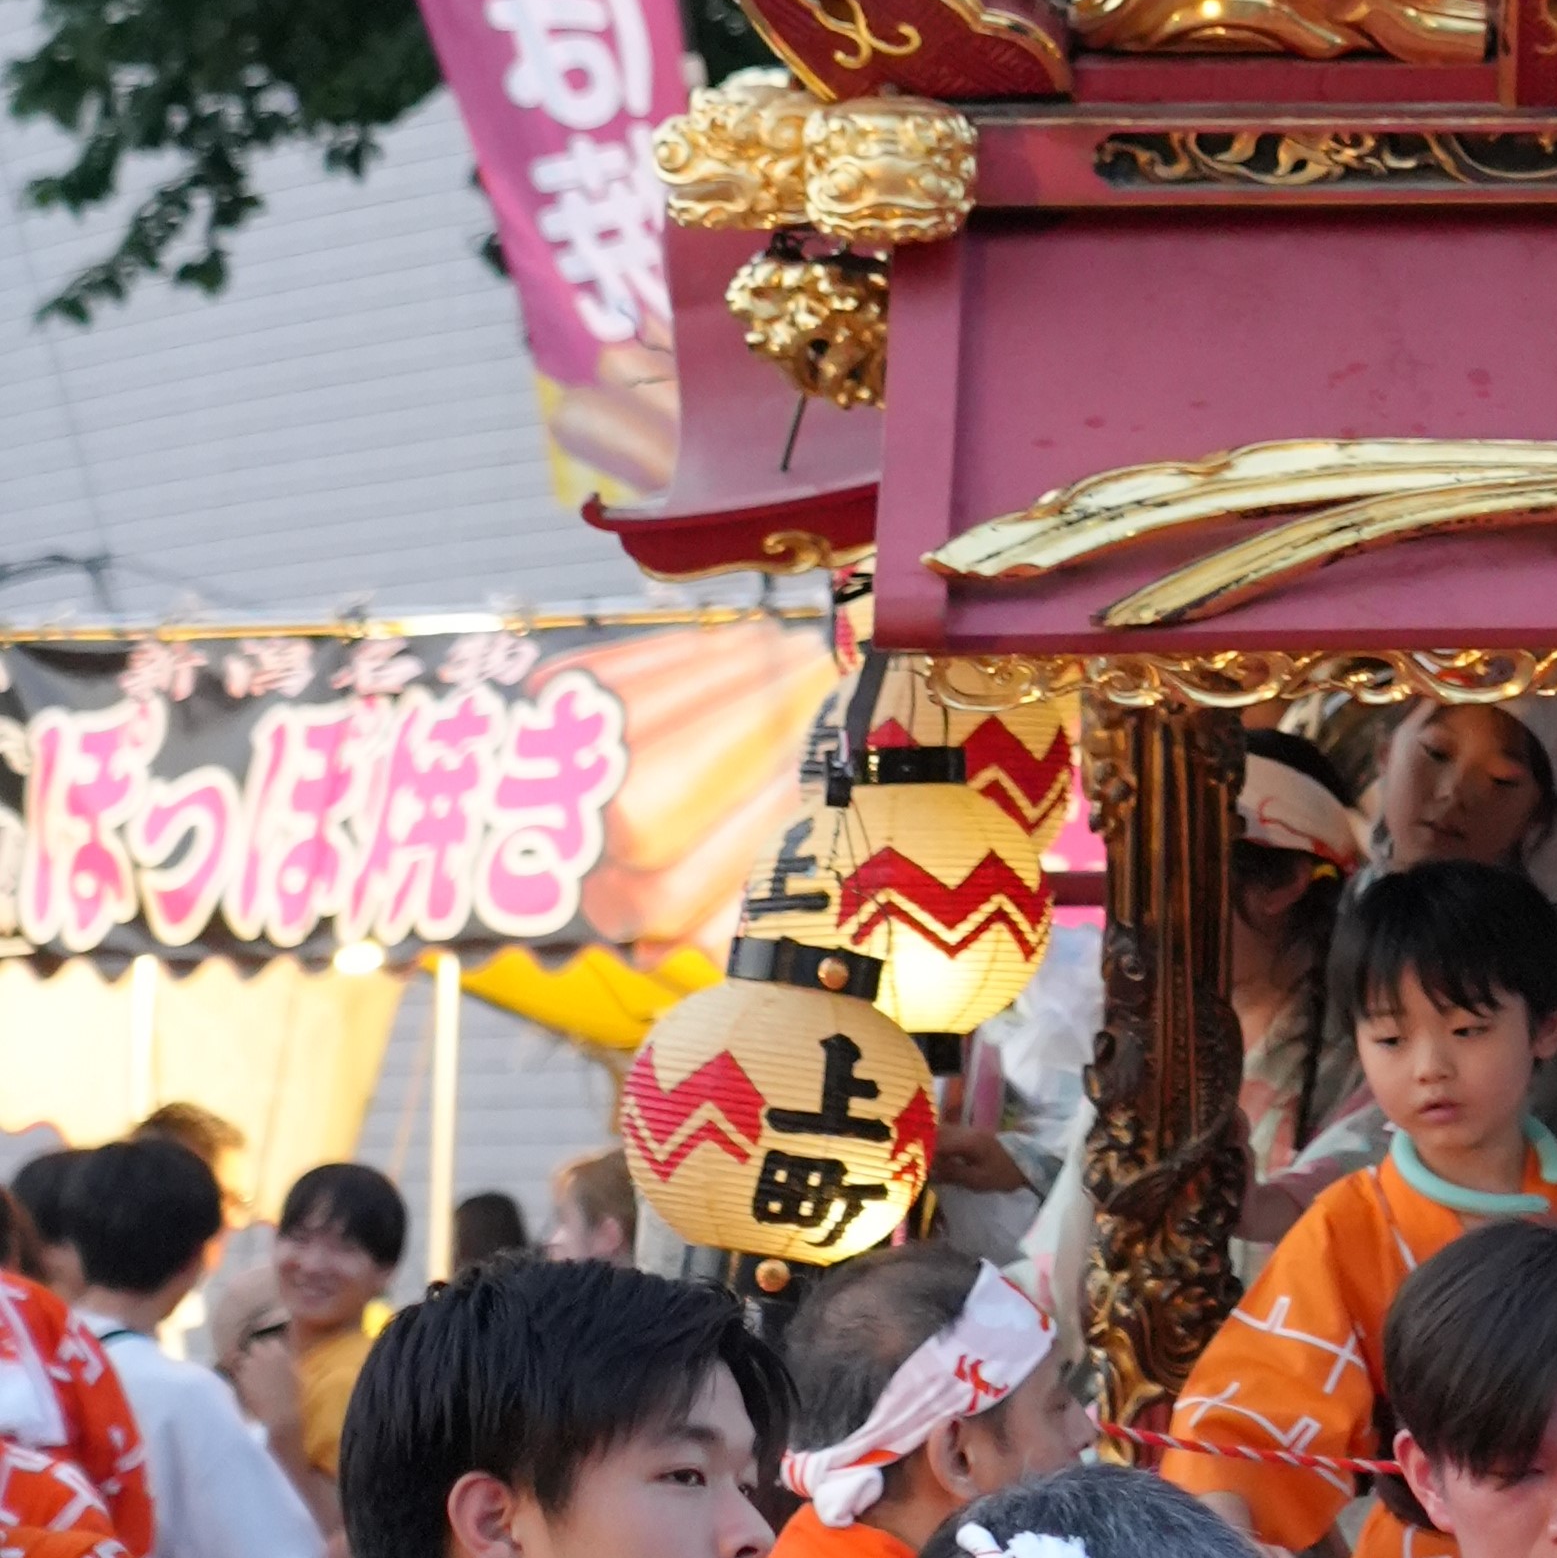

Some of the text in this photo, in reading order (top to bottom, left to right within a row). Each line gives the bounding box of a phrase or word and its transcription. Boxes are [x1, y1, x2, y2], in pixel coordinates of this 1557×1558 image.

[120, 636, 540, 699] 新潟名物
[751, 1033, 892, 1248] 上町
